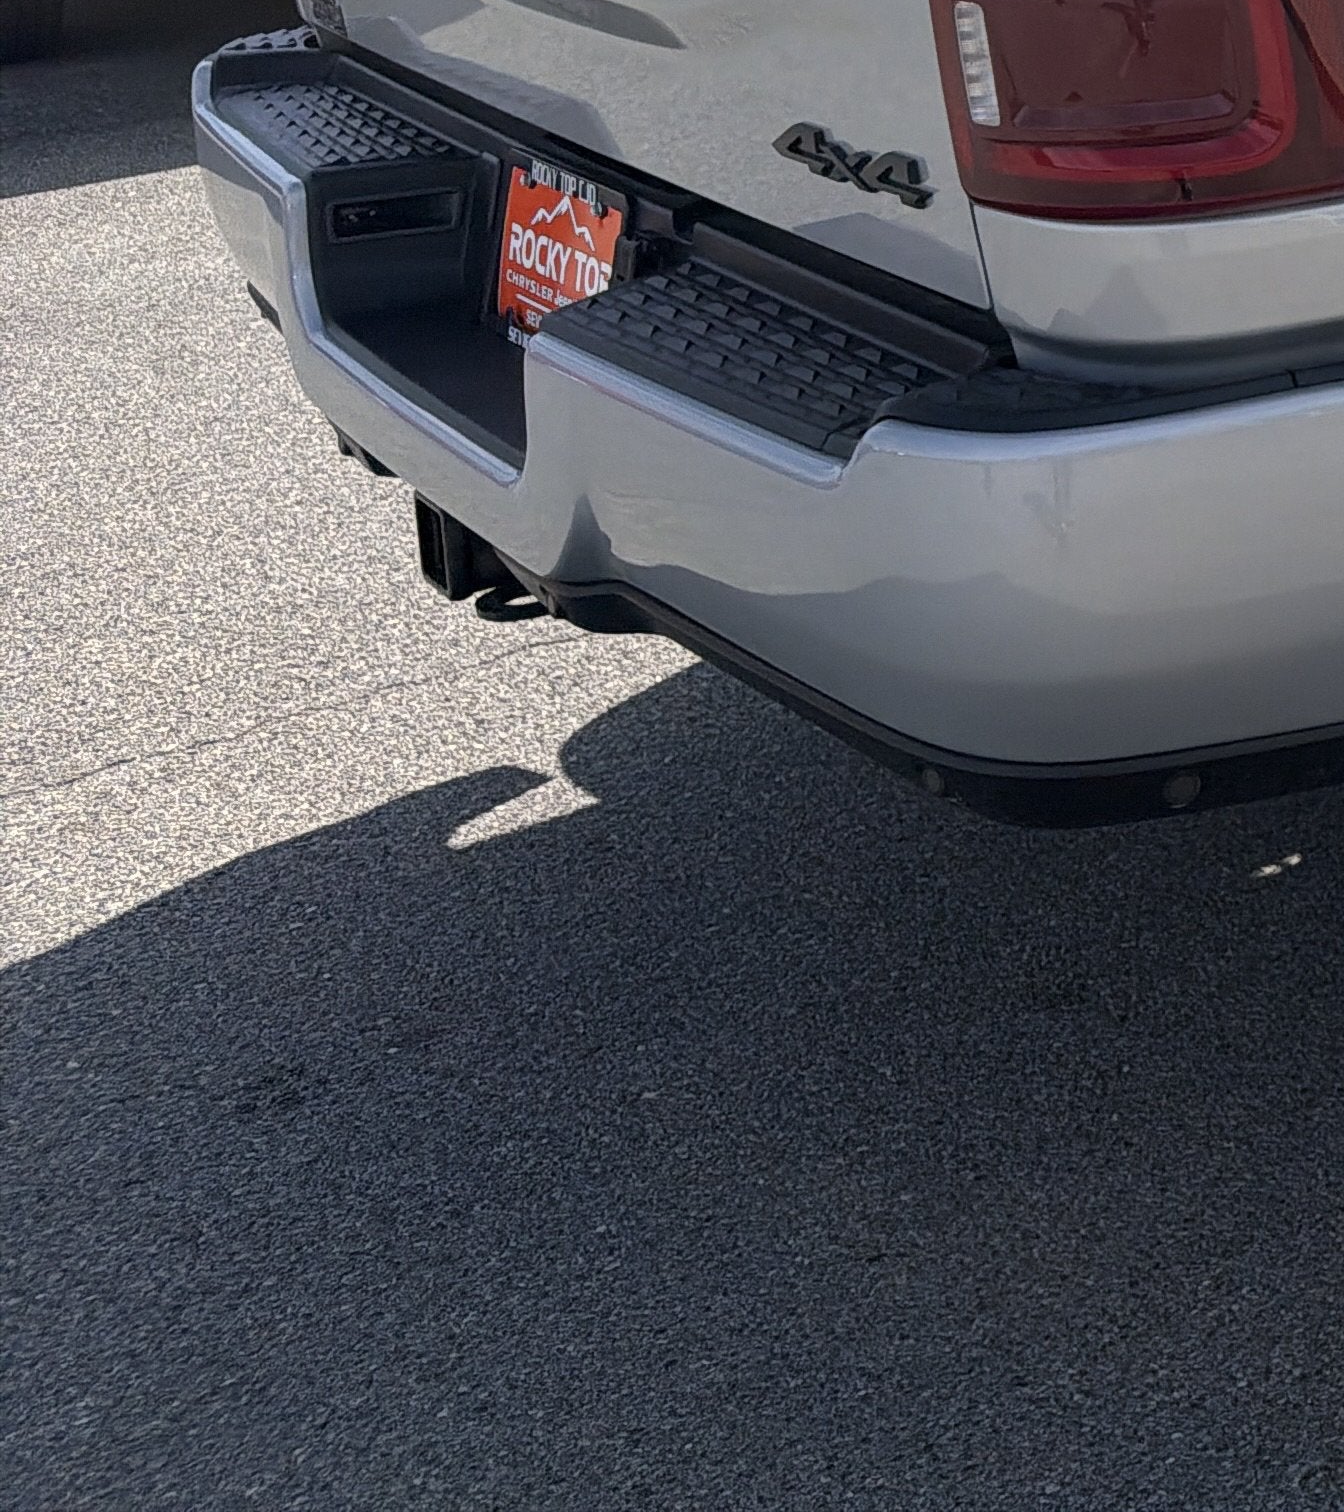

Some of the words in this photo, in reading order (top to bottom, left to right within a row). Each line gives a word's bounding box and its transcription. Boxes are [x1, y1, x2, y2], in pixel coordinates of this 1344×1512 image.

[531, 159, 559, 191] ROCKY
[560, 171, 577, 196] TOP
[508, 222, 572, 285] ROCKY
[574, 251, 613, 297] TOP
[506, 269, 553, 303] CHRYSLER
